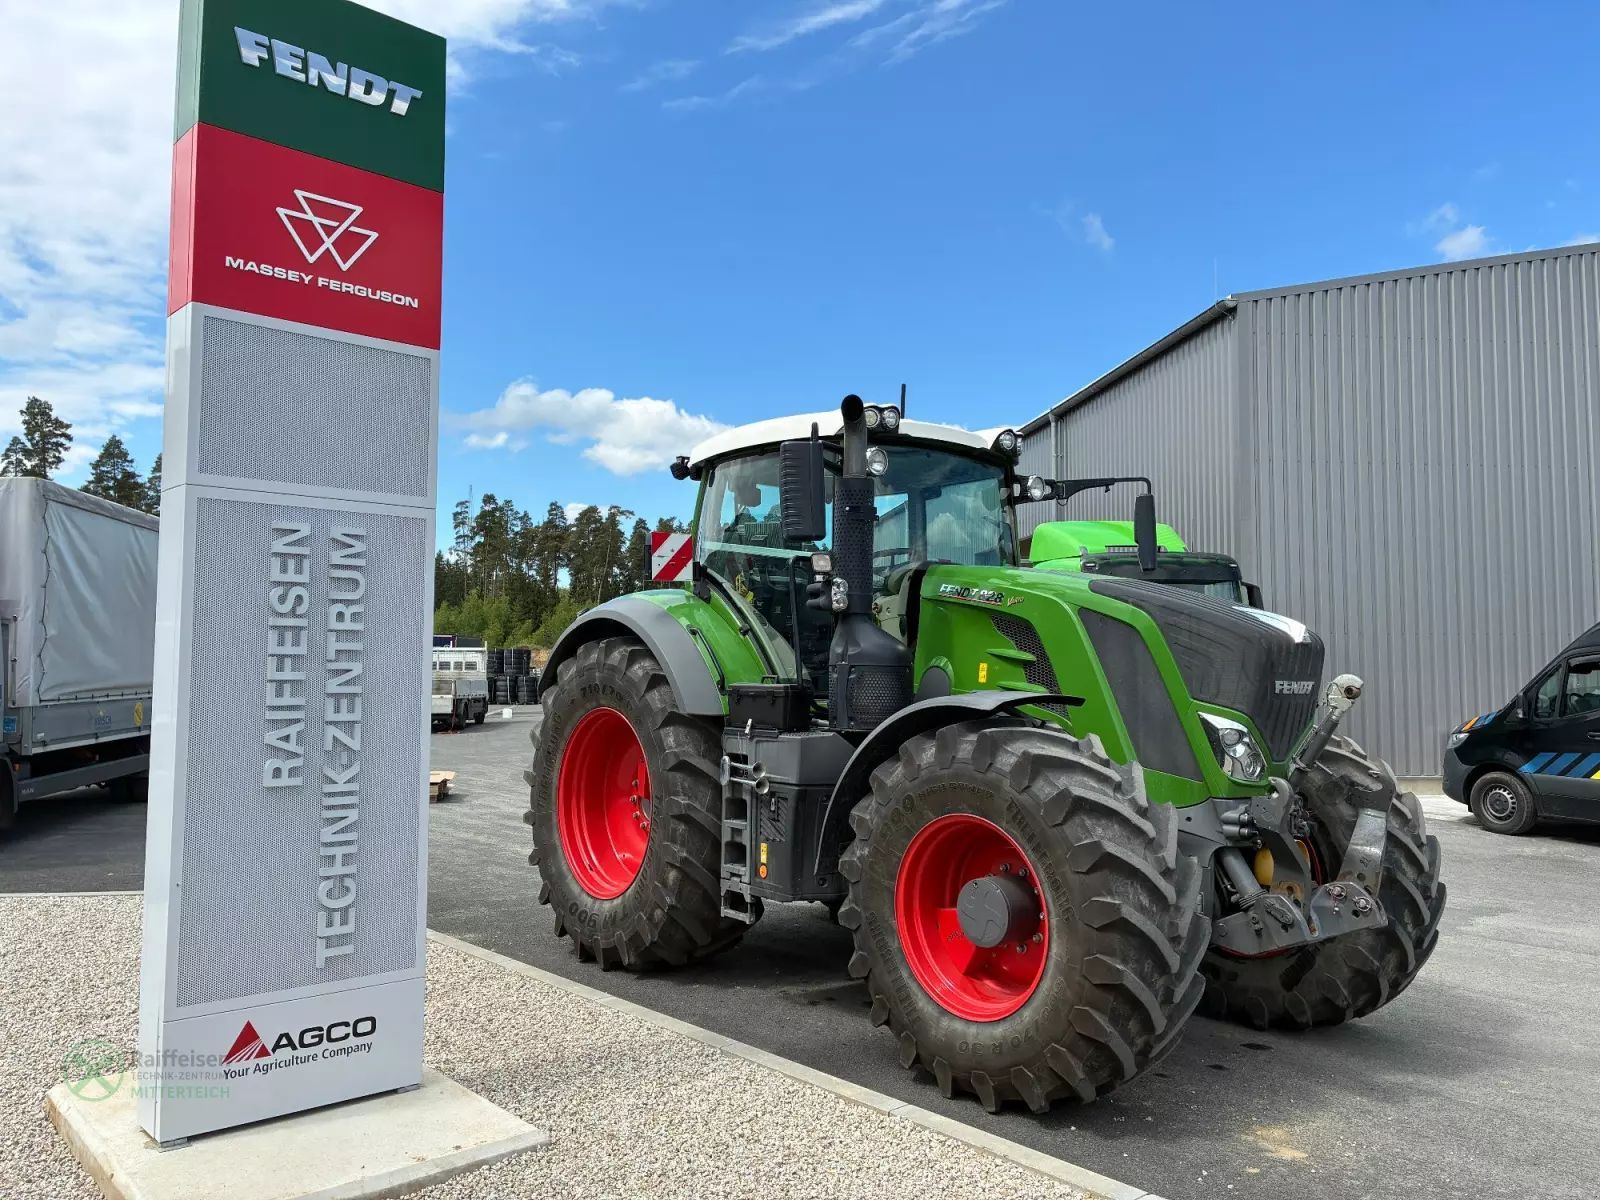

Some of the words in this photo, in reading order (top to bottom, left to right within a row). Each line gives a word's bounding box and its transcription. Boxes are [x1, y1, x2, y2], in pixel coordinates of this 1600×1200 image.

[233, 26, 423, 116] FENDT
[225, 255, 313, 285] MASSEY
[318, 274, 419, 309] FERGUSON
[940, 583, 979, 598] FENDT
[263, 521, 312, 789] RAIFFEISEN
[1274, 680, 1315, 695] FENDT
[315, 526, 367, 969] TECHNIK-ZENTRUM
[271, 1016, 377, 1054] AGCO
[223, 1066, 251, 1080] Your
[252, 1051, 319, 1075] Agriculture
[321, 1041, 373, 1059] Company
